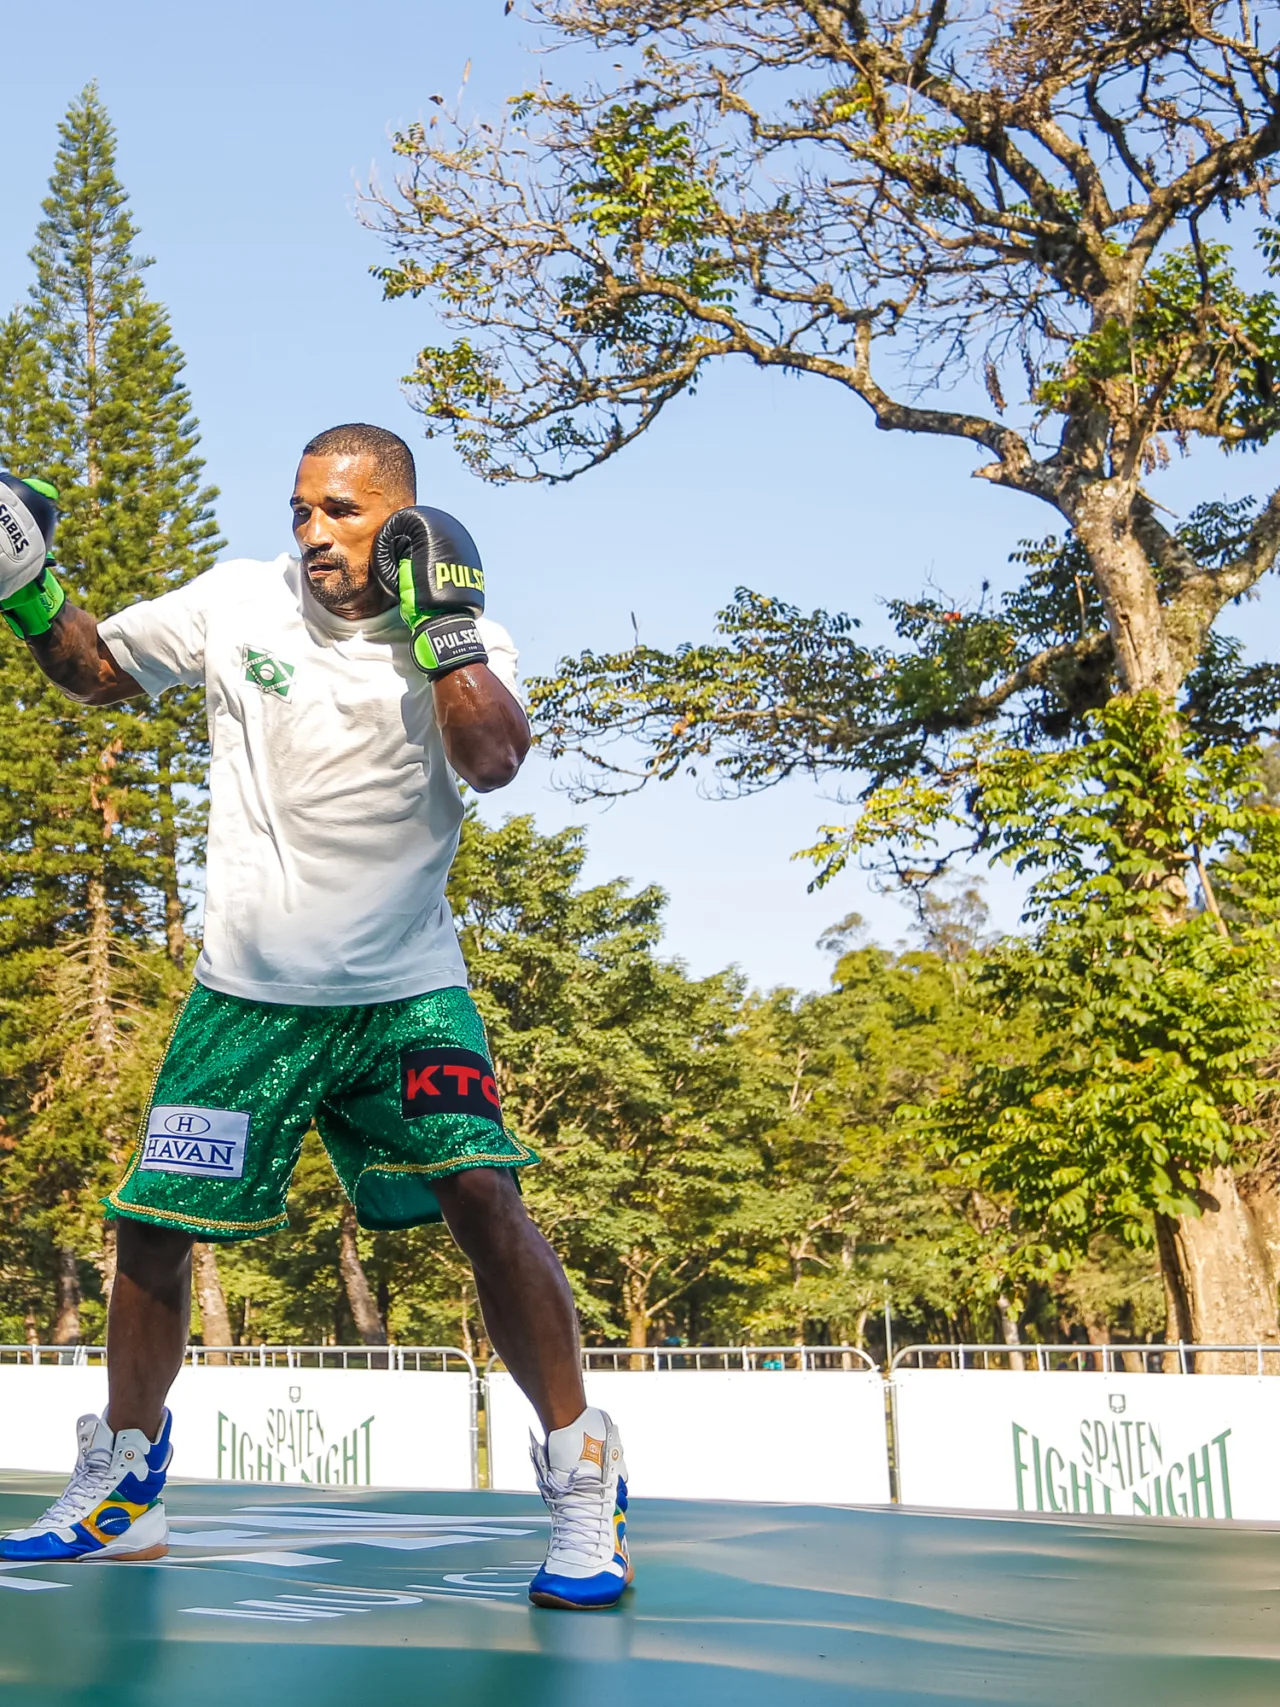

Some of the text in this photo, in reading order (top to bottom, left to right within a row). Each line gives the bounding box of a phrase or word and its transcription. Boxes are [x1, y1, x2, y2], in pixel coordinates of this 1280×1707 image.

[146, 1139, 235, 1165] HAVAN
[176, 1116, 195, 1132] H
[217, 1410, 375, 1485] FIGHT NIGHT
[266, 1408, 325, 1467] SPATEN
[1012, 1420, 1233, 1520] FIGHT NIGHT
[1080, 1419, 1163, 1490] SPATEN
